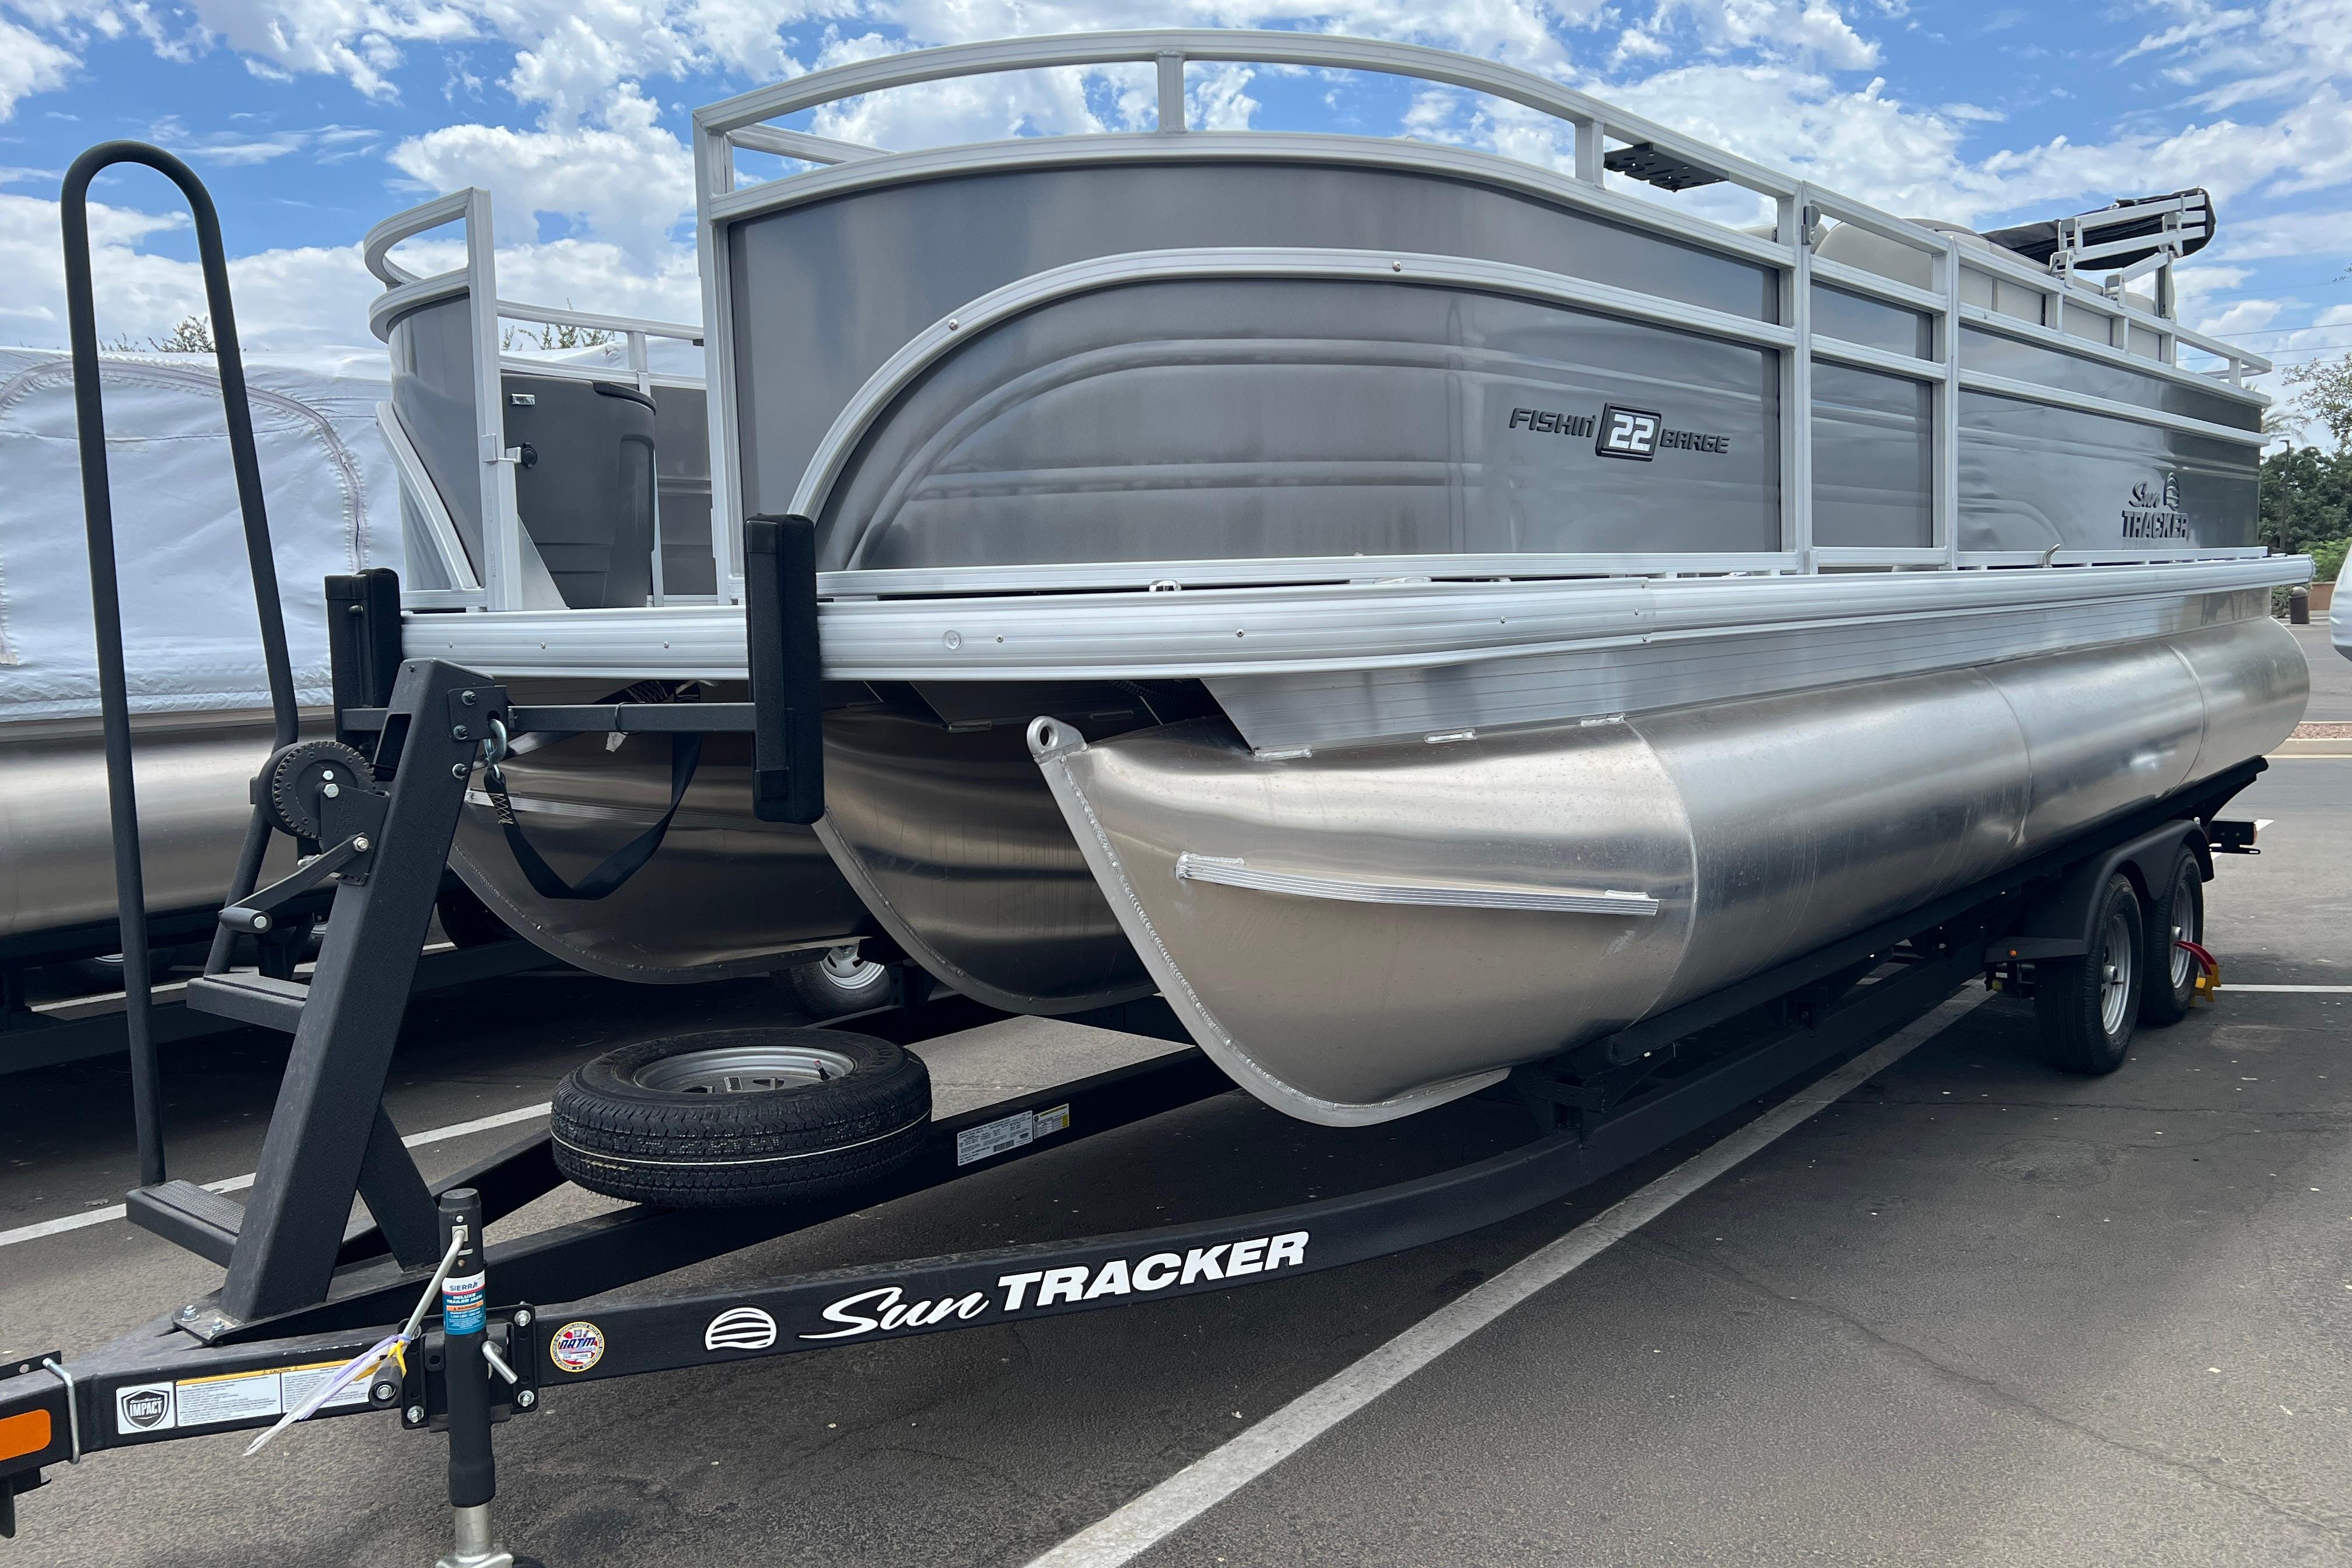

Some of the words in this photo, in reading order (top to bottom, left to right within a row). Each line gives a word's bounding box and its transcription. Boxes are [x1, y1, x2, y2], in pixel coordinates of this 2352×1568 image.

[1609, 414, 1654, 451] 22
[1659, 428, 1731, 454] BARGE
[2128, 481, 2161, 508] Sun
[2122, 510, 2189, 538] TRACKER
[449, 1282, 478, 1292] SIERRA
[799, 1287, 989, 1338] Sun
[998, 1231, 1308, 1311] TRACKER
[559, 1337, 596, 1349] NATM
[129, 1400, 162, 1417] IMPACT
